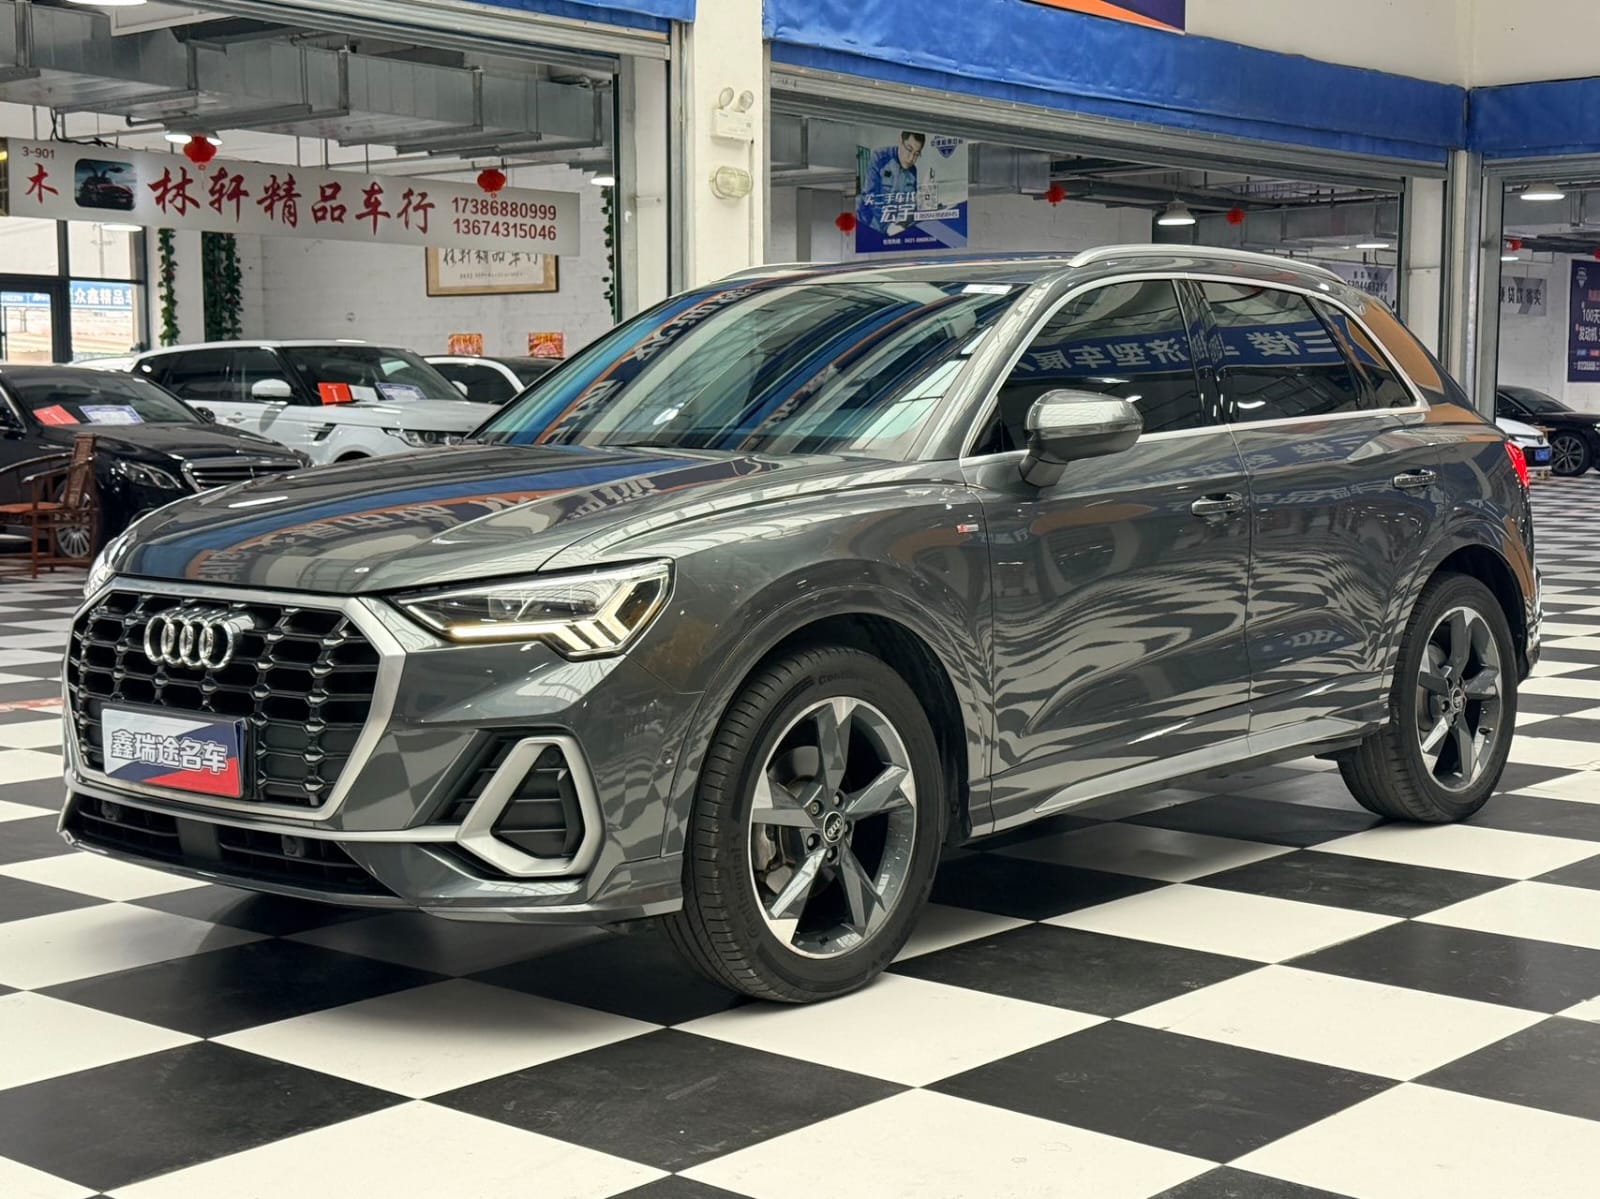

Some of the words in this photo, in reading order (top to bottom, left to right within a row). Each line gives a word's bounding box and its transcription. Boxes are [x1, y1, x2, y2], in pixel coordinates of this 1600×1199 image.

[22, 146, 55, 160] 3-901
[147, 166, 436, 235] 林轩精品车行
[452, 196, 557, 221] 17386880999
[453, 218, 557, 241] 13674315046
[111, 729, 228, 774] 鑫瑞途名车
